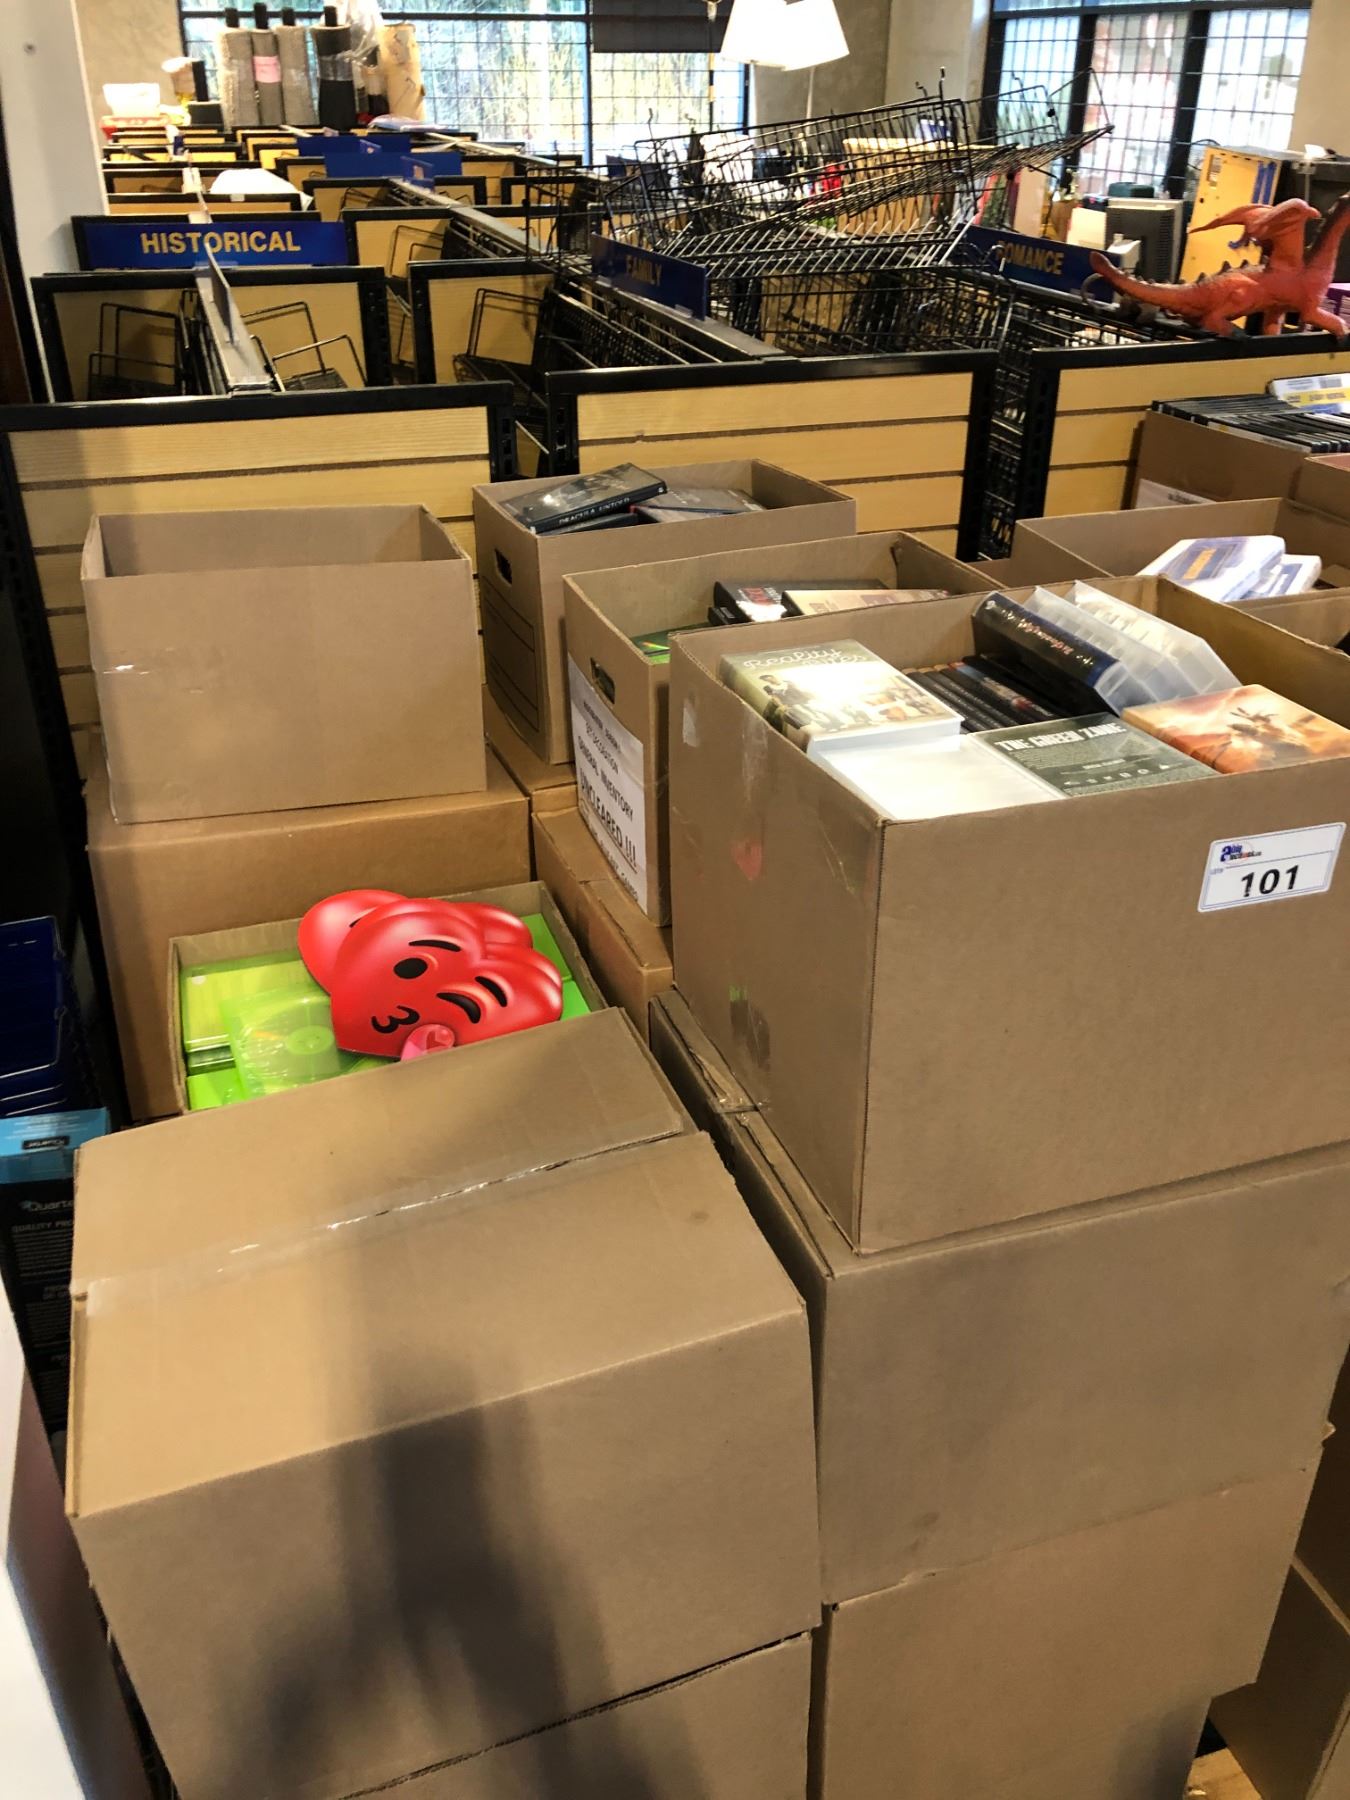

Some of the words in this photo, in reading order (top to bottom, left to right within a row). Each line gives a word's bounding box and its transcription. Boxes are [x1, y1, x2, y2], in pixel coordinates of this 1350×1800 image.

[140, 230, 302, 254] HISTORICAL
[993, 737, 1034, 751] THE
[1028, 730, 1084, 748] GREEN
[1078, 722, 1128, 740] ZONE
[1241, 865, 1299, 897] 101
